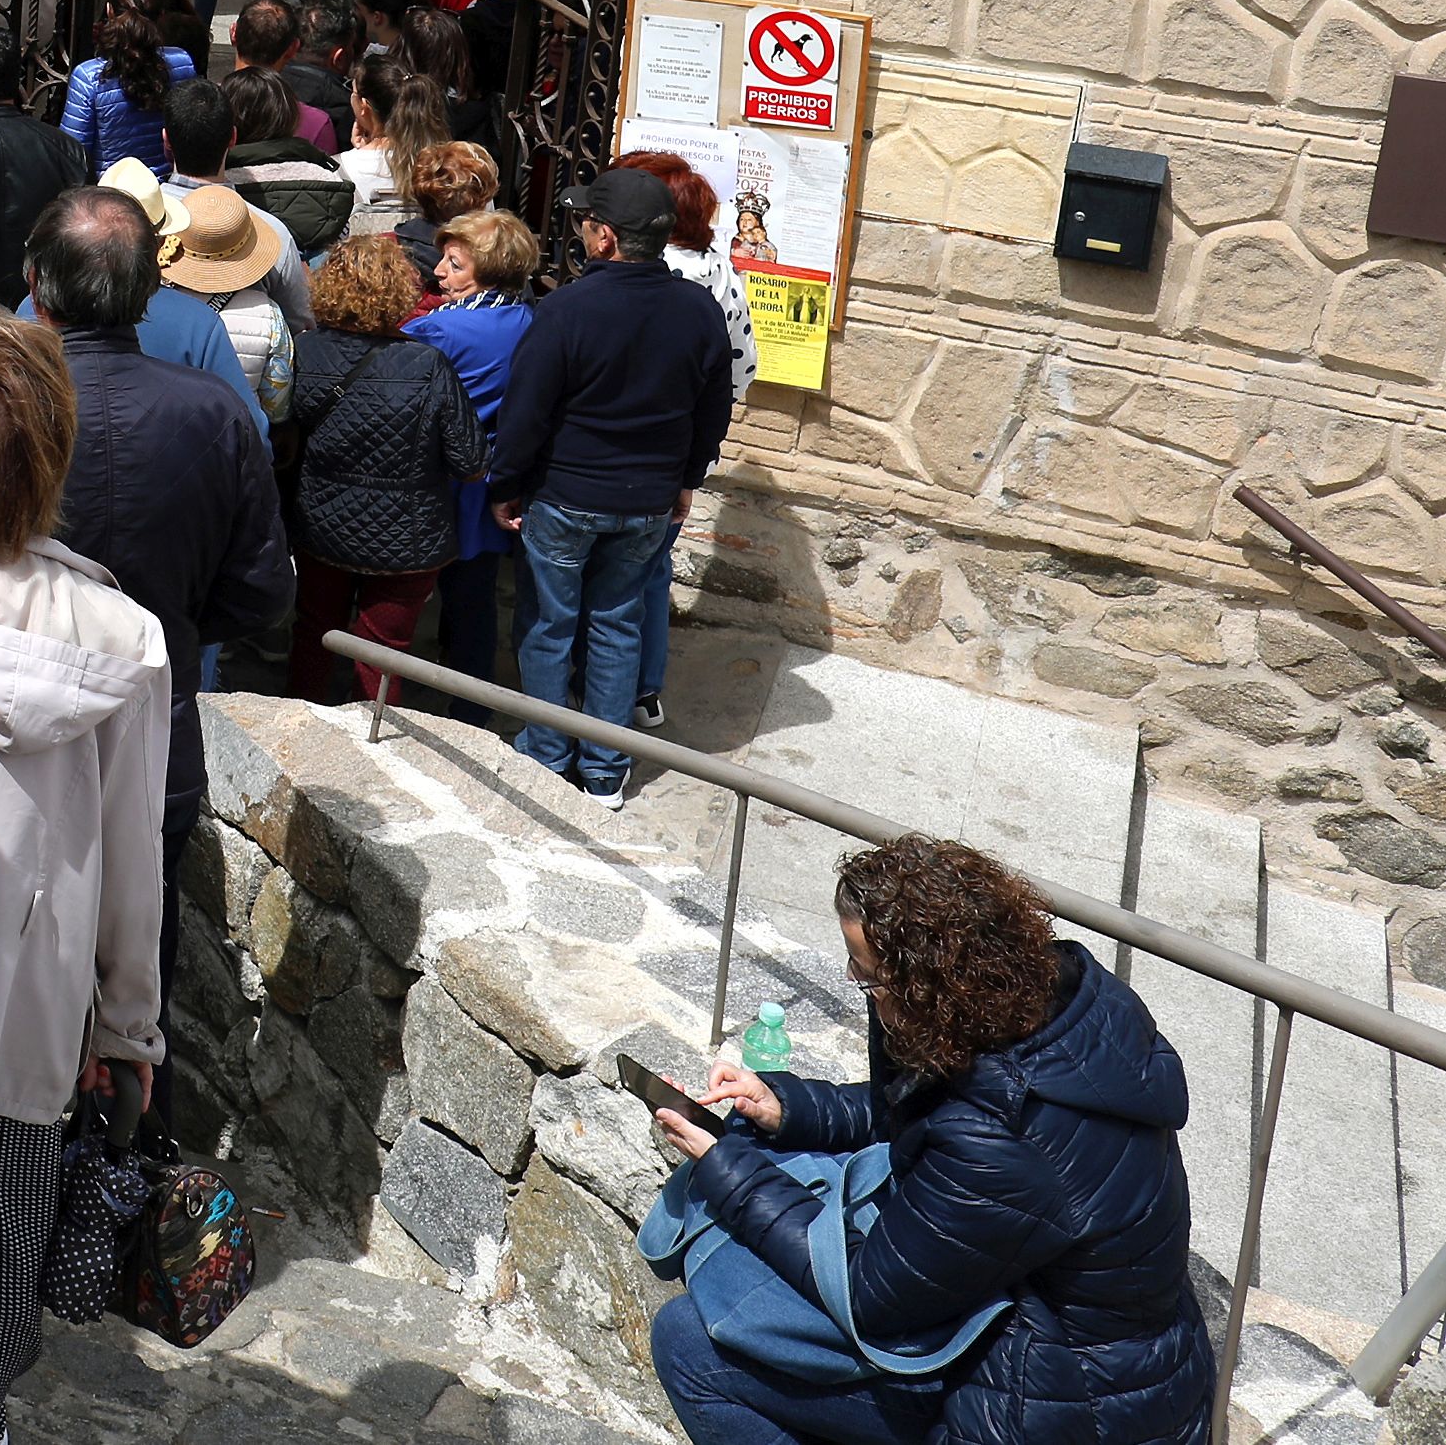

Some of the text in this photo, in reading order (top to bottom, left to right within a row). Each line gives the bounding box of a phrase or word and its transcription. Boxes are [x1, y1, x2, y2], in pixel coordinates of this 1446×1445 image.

[748, 90, 829, 110] PROHIBIDO
[758, 103, 818, 121] PERROS
[640, 133, 719, 151] PROHIBIDO PONER
[680, 150, 711, 162] RIESGO
[713, 155, 725, 163] DE
[740, 159, 775, 172] tra. Sra.
[738, 167, 771, 178] el Valle
[749, 274, 788, 289] ROSARIO
[755, 288, 780, 300] DE LA
[749, 300, 784, 313] AURORA
[777, 320, 795, 330] MAYO
